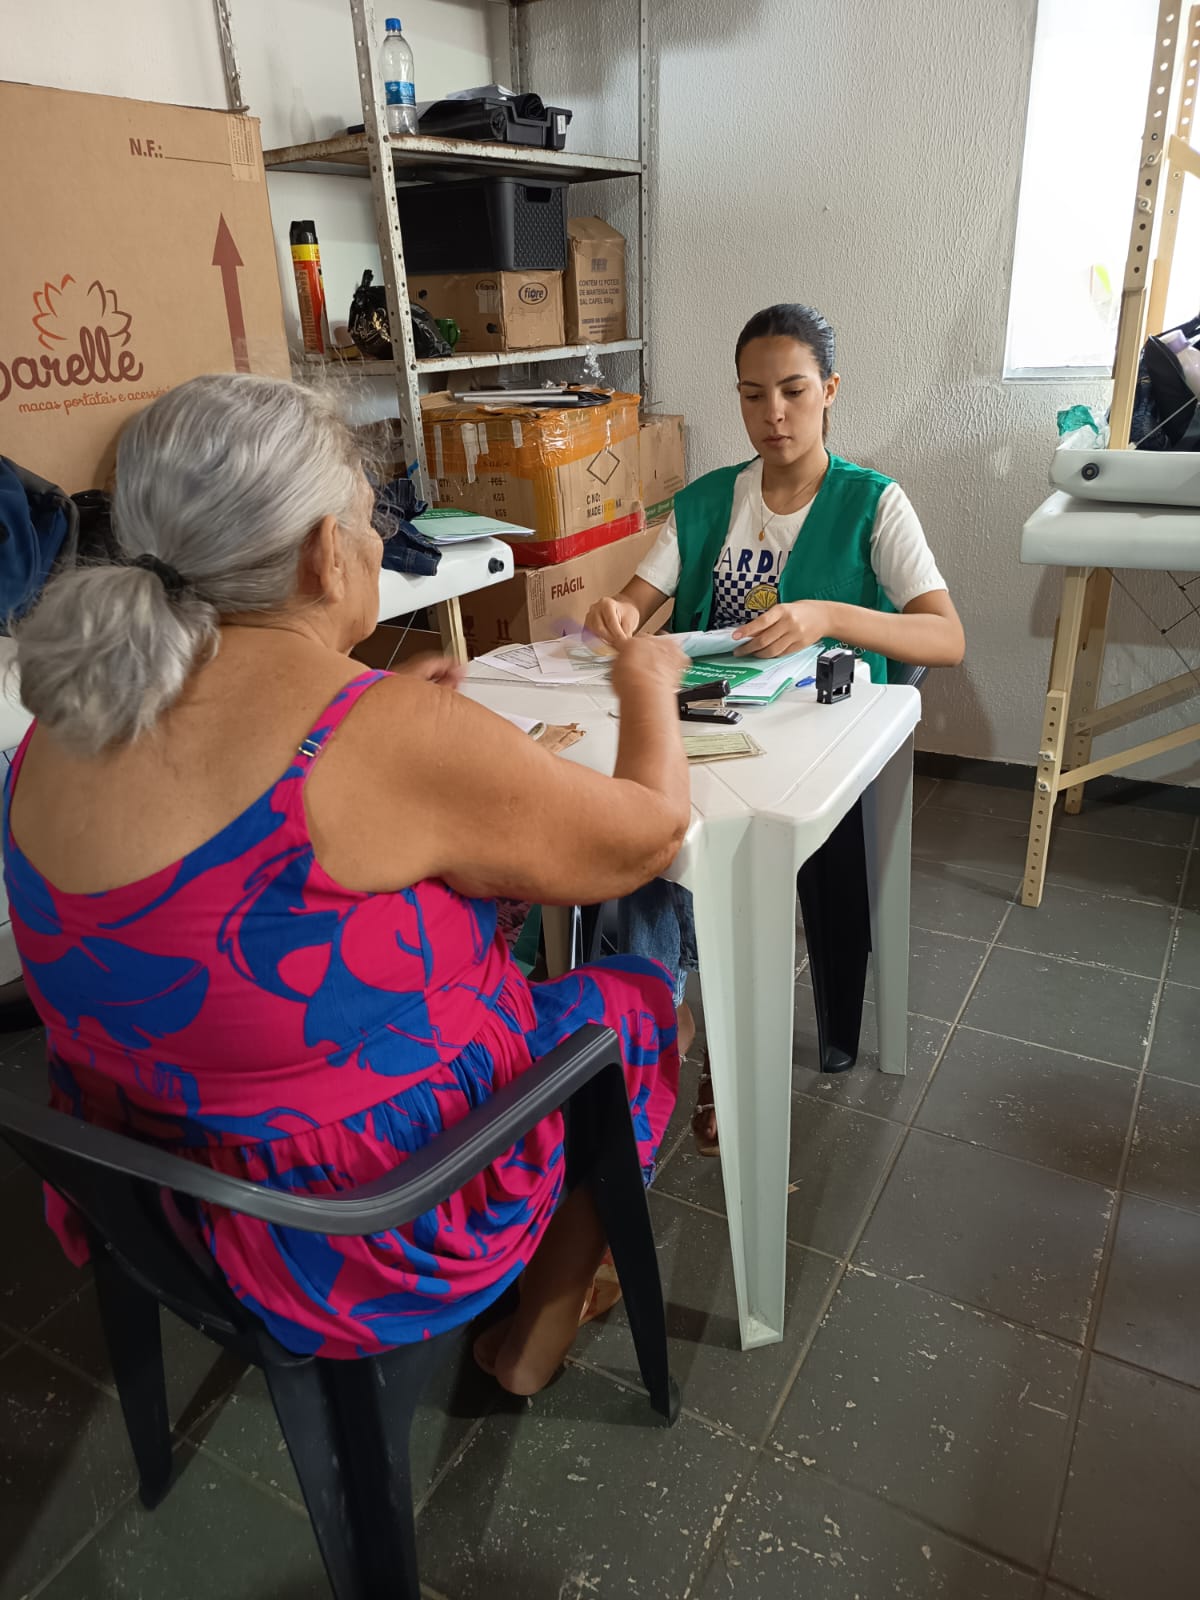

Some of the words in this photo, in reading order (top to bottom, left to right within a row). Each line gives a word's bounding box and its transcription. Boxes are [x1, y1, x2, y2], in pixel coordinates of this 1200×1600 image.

[19, 401, 61, 413] macas
[119, 393, 126, 402] e
[551, 576, 585, 600] FRÁGIL
